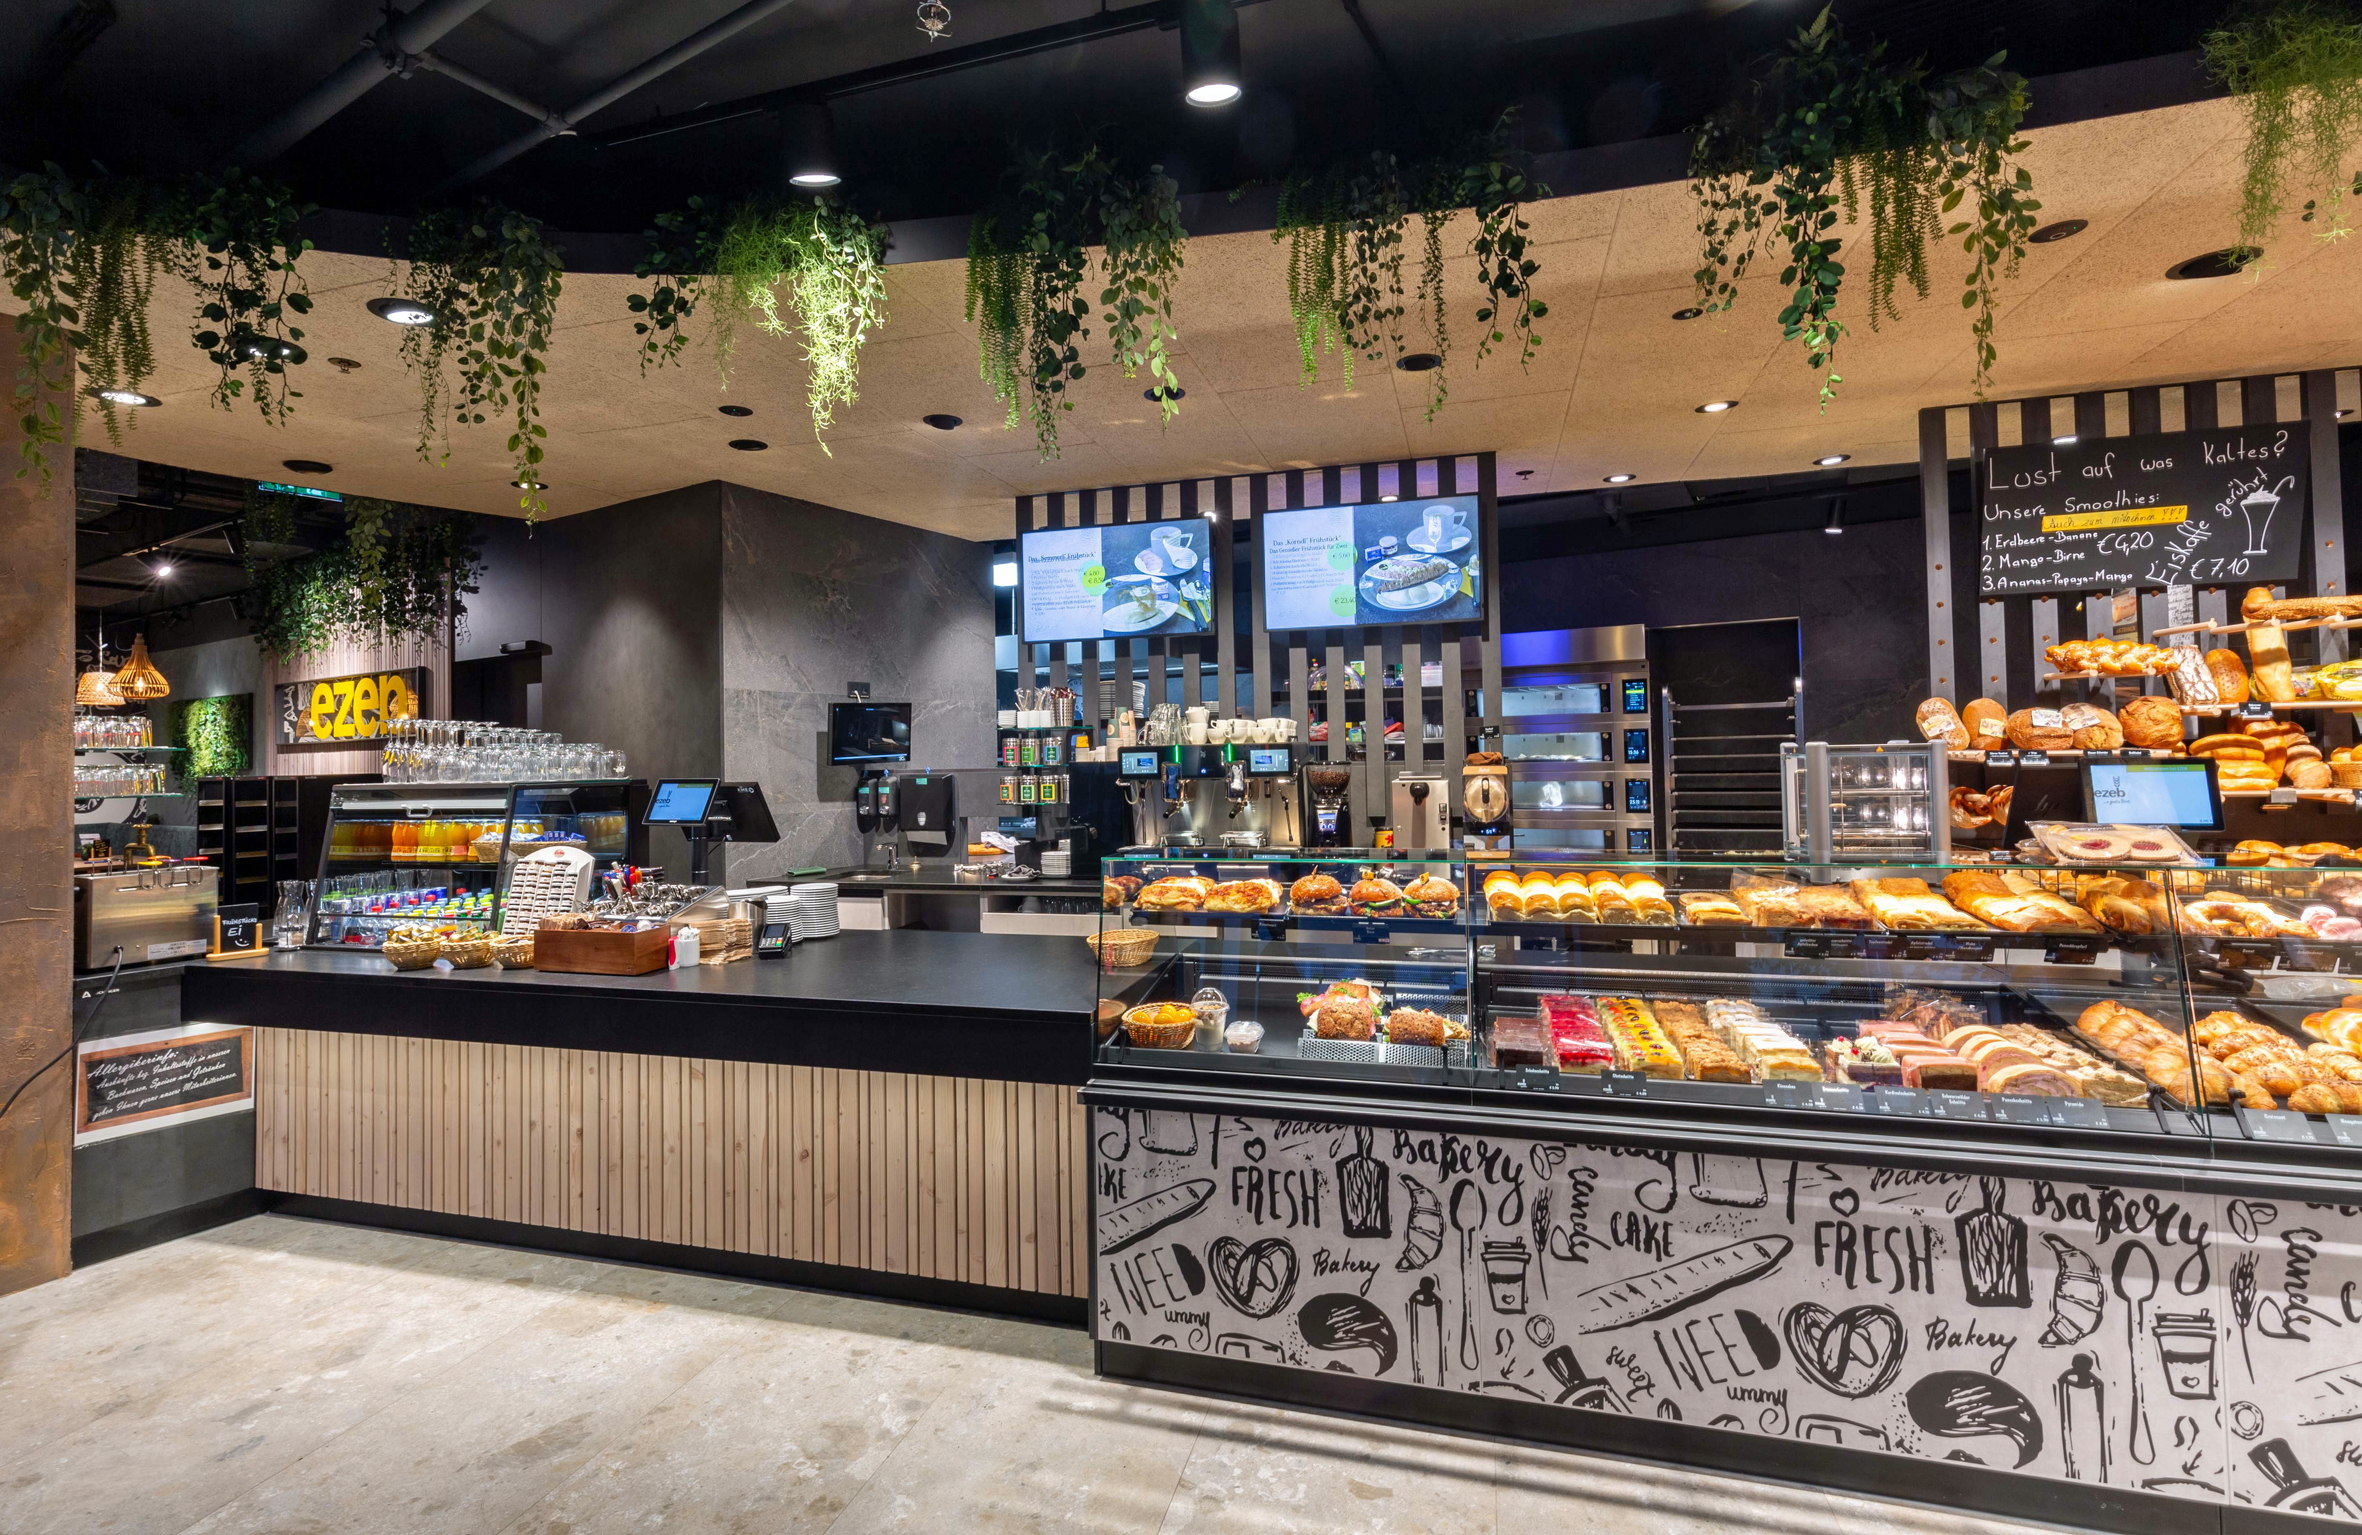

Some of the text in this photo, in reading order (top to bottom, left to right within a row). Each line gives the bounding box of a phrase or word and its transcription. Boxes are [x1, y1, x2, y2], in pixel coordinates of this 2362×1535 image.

[1989, 430, 2288, 490] Lust auf was Kaltes?
[1984, 489, 2159, 522] Unsere Smoothies:
[2215, 466, 2268, 518] gerührt
[2042, 517, 2076, 530] Auch
[2081, 517, 2104, 527] zum
[1999, 548, 2085, 568] Mango-Birne
[2094, 786, 2126, 798] ezeb
[227, 925, 243, 937] Ei
[87, 1048, 179, 1079] Allergikerinfo:
[1231, 1165, 1320, 1229] FRESH
[1391, 1127, 1525, 1227] Bakery
[1610, 1211, 1675, 1262] CAKE
[1814, 1220, 1935, 1295] FRESH
[2027, 1179, 2212, 1296] Bakery
[1312, 1246, 1382, 1297] Bakery
[1925, 1315, 2018, 1376] Bakery
[1604, 1345, 1656, 1403] sweet
